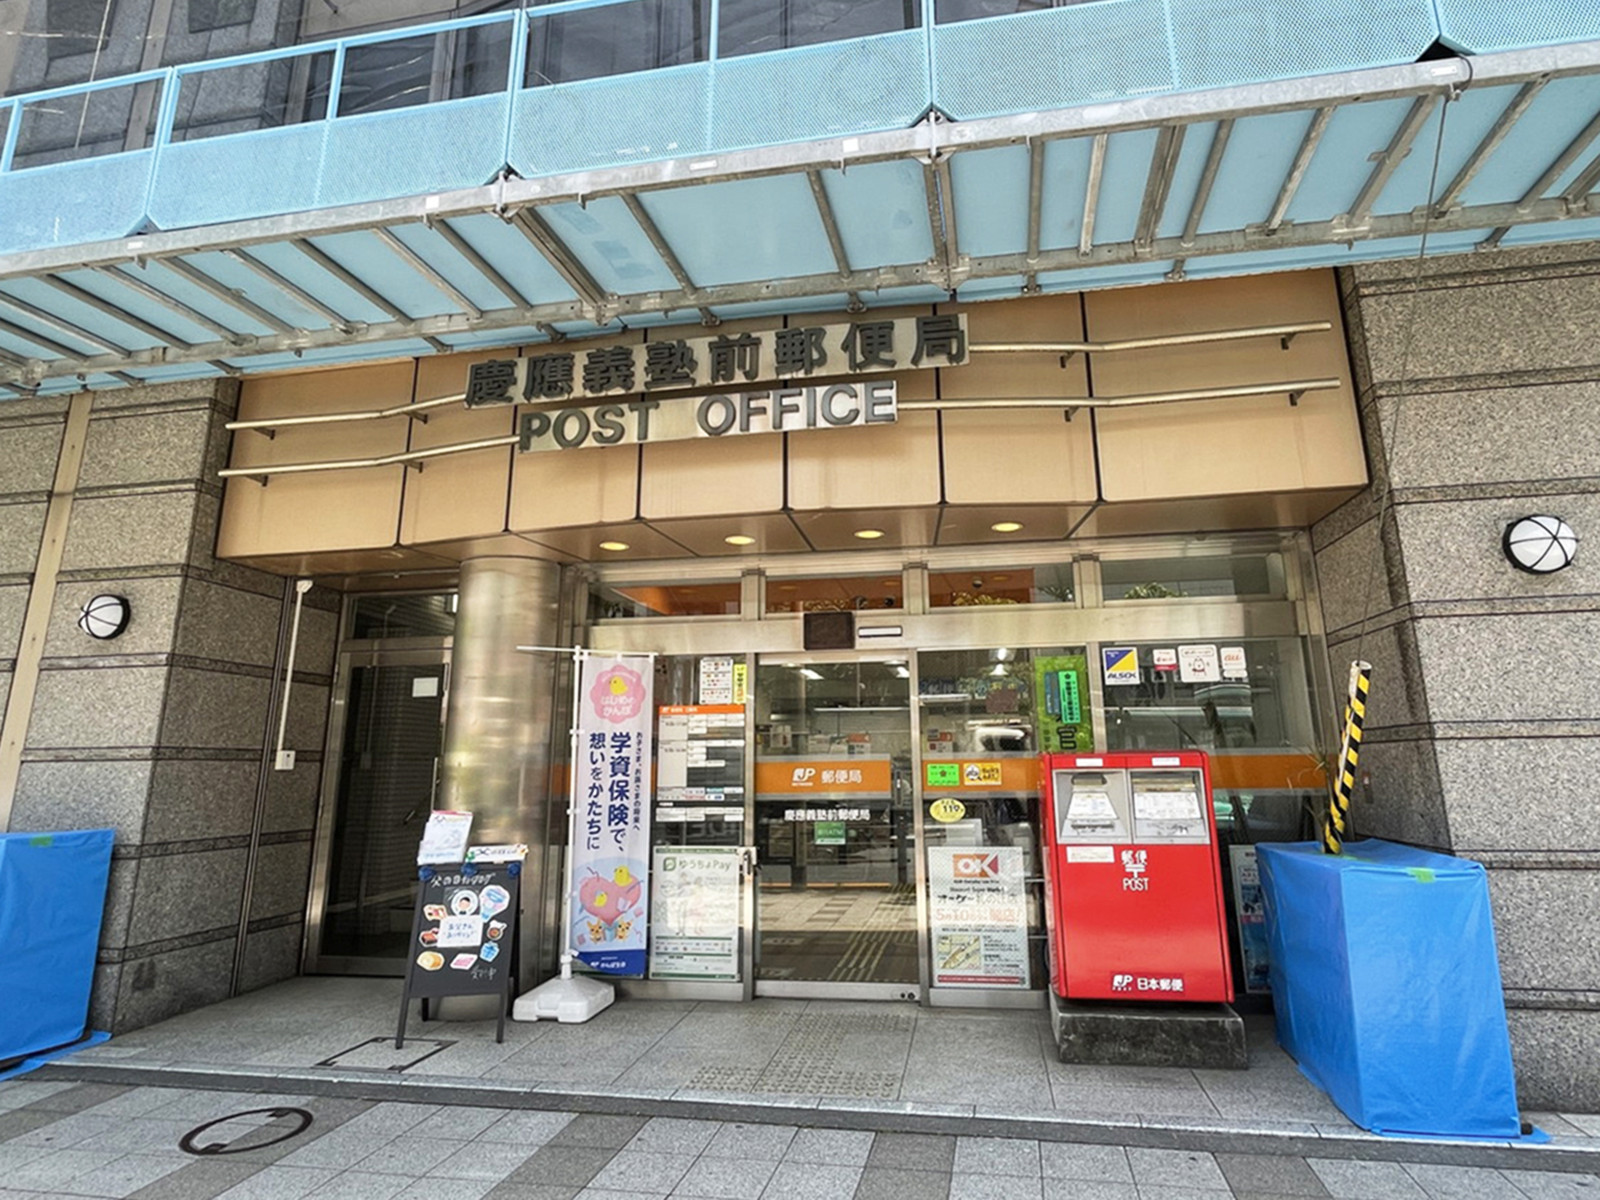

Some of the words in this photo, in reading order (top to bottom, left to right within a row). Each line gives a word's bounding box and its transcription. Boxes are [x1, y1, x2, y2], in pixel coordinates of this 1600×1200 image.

[466, 313, 966, 406] 慶應義塾前郵便局
[520, 400, 660, 451] POST
[697, 381, 897, 436] OFFICE
[821, 768, 862, 784] 郵便局
[586, 732, 606, 851] 想いをかたちに
[608, 731, 631, 852] 学資保険で、
[955, 853, 999, 879] OK
[1121, 849, 1148, 865] 郵便
[1122, 877, 1149, 891] POST
[1112, 974, 1134, 988] JP
[1137, 976, 1184, 992] 日本郵便
